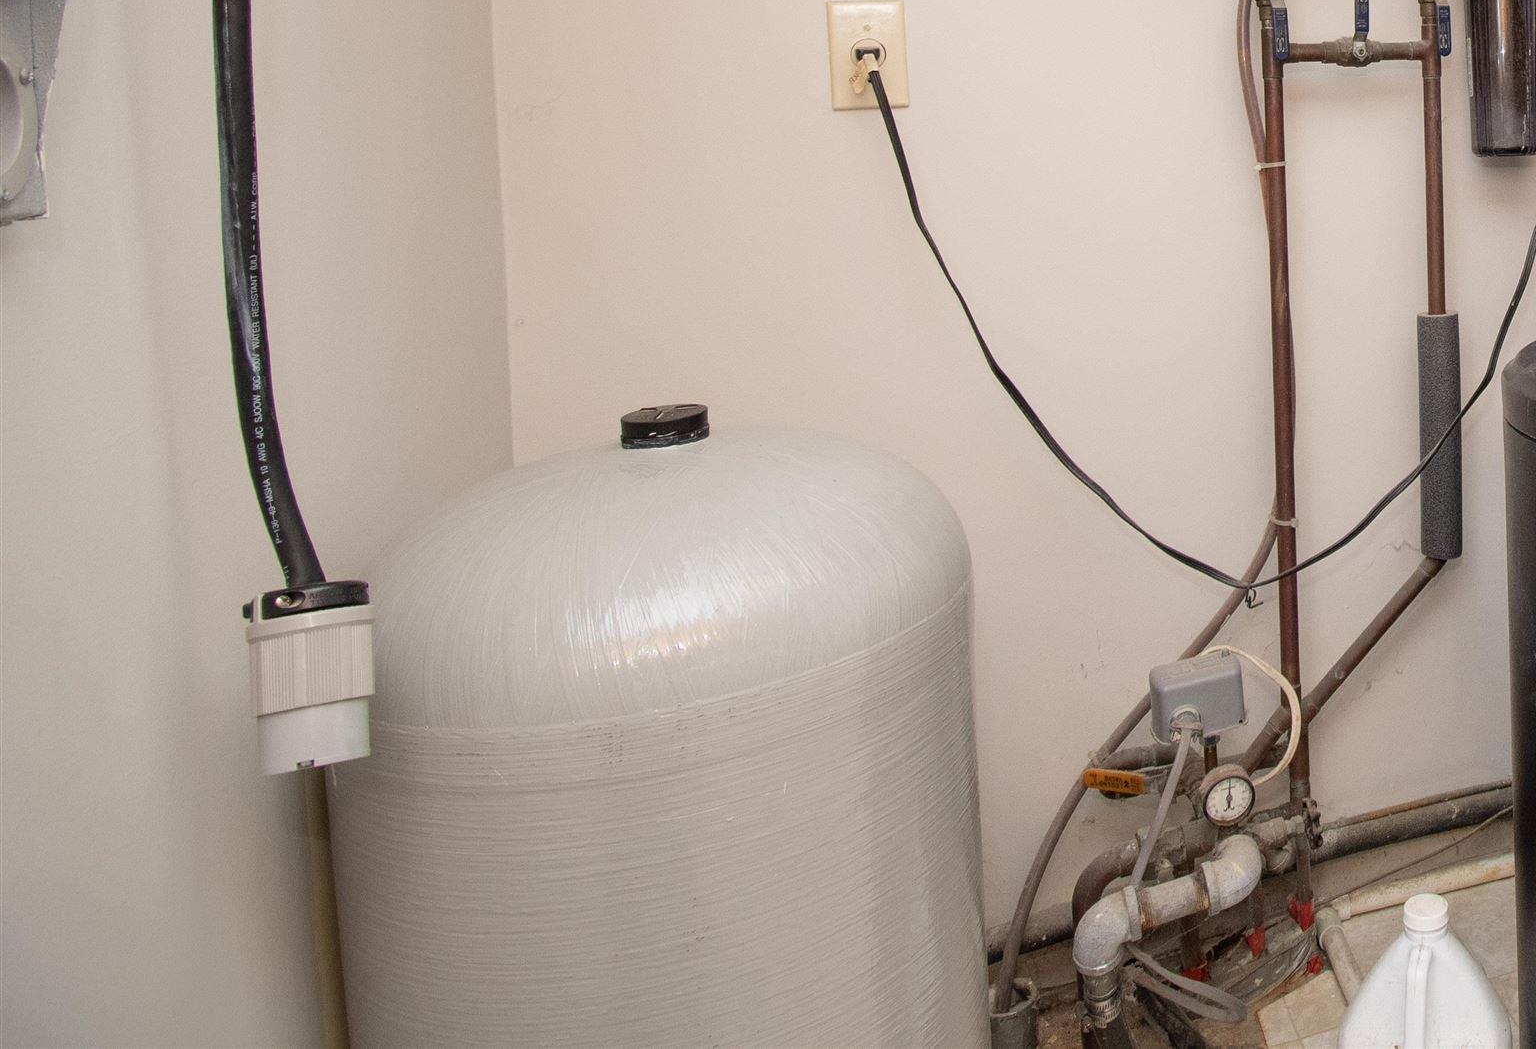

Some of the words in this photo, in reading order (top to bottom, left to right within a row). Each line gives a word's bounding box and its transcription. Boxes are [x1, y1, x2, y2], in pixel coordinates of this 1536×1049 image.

[250, 275, 260, 318] RESISTANT
[251, 320, 260, 350] WATER
[252, 395, 262, 423] SJOOW
[256, 442, 267, 462] AWG
